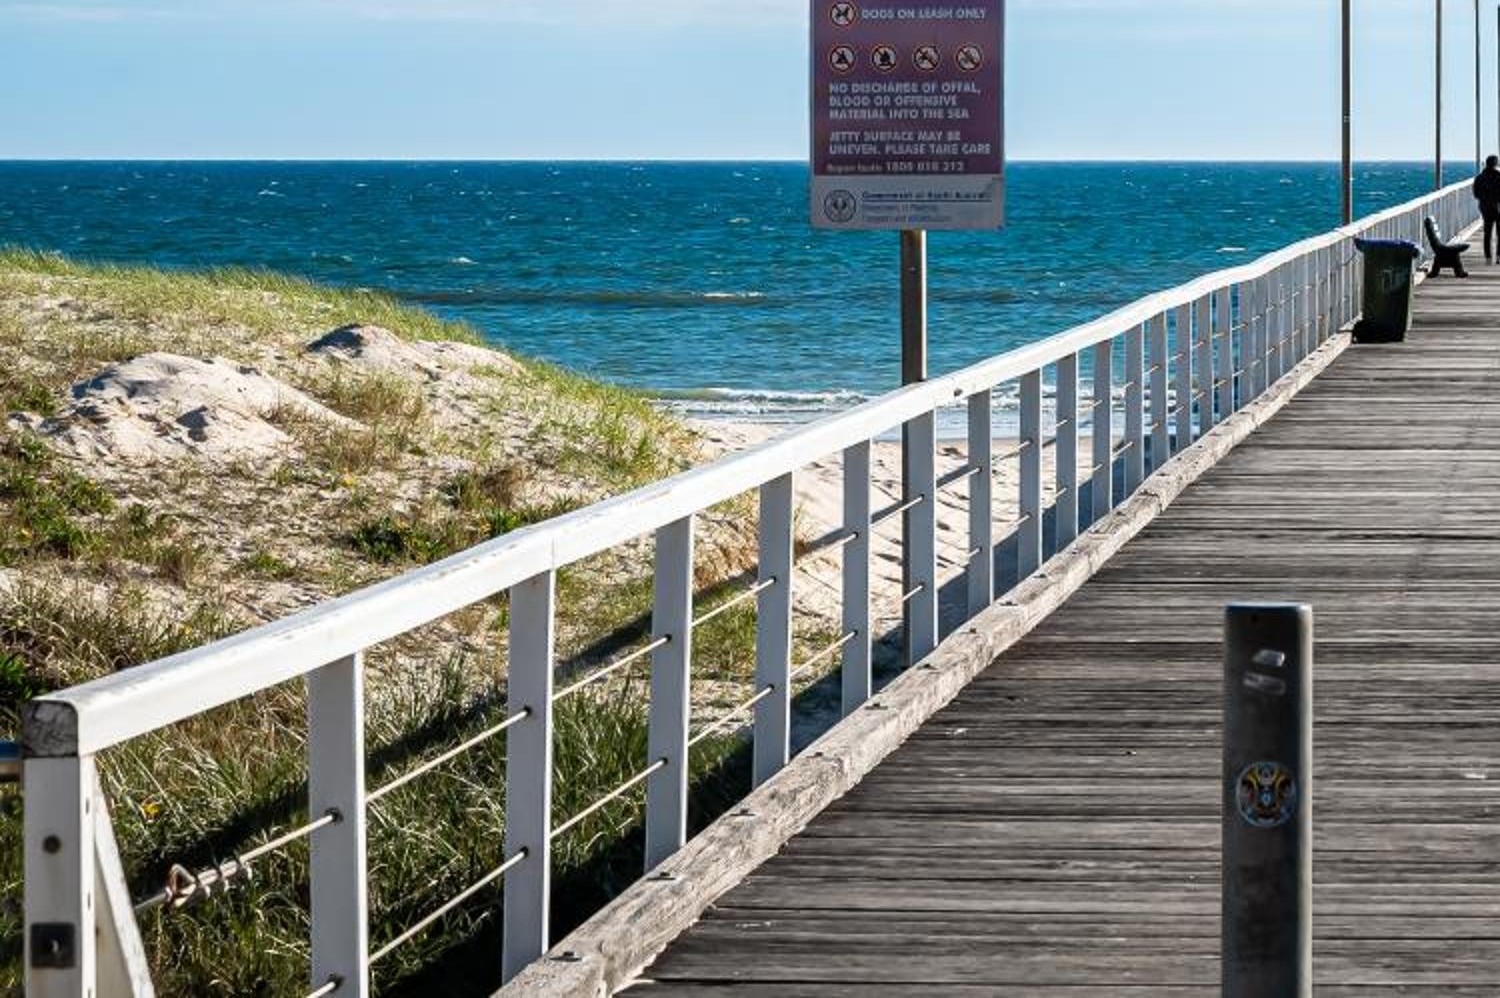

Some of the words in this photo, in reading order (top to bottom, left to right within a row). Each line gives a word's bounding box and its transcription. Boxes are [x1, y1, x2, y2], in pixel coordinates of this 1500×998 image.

[862, 9, 894, 19] DOGS
[898, 9, 915, 19] ON
[920, 9, 953, 19] LEASH
[956, 9, 986, 19] ONLY
[829, 82, 848, 93] NO
[851, 82, 918, 93] DISCHARGE
[922, 82, 937, 93] OF
[941, 82, 982, 95] OFFAL,
[829, 96, 871, 106] BLOOD
[874, 96, 891, 106] OR
[895, 96, 957, 106] OFFENSIVE
[829, 109, 885, 119] MATERIAL
[889, 109, 918, 119] INTO
[922, 109, 944, 119] THE
[947, 109, 969, 119] SEA
[829, 131, 861, 141] JETTY
[864, 131, 914, 141] SURFACE
[917, 131, 943, 141] MAY
[947, 131, 961, 141] BE
[829, 143, 880, 154] UNEVEN.
[885, 143, 926, 154] PLEASE
[929, 143, 958, 154] TAKE
[961, 143, 992, 154] CARE
